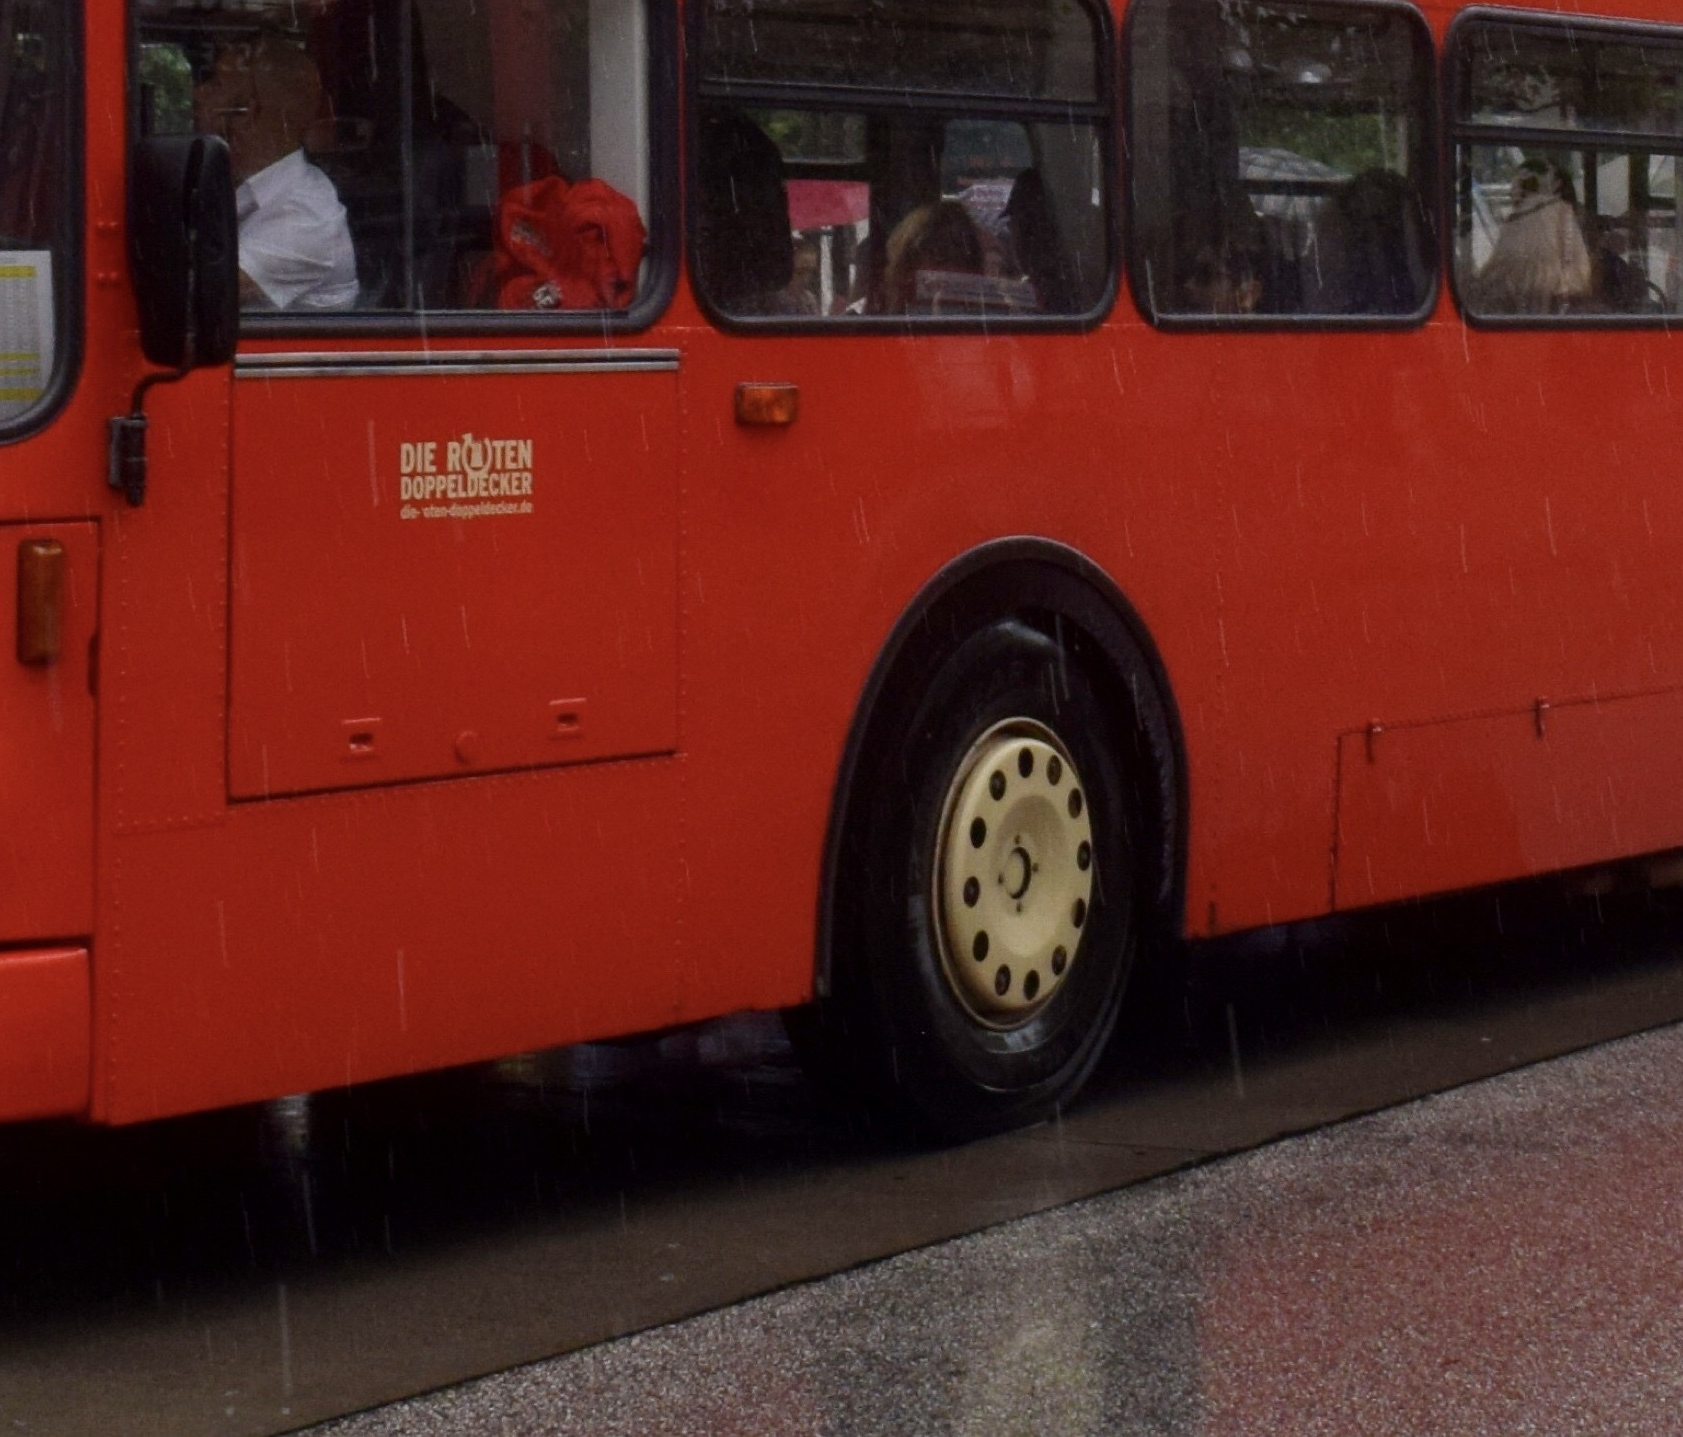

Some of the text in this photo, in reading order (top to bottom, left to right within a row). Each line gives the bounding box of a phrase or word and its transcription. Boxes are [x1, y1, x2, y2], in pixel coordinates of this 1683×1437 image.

[401, 433, 533, 473] DIE ROTEN
[400, 472, 533, 500] DOPPELDECKER
